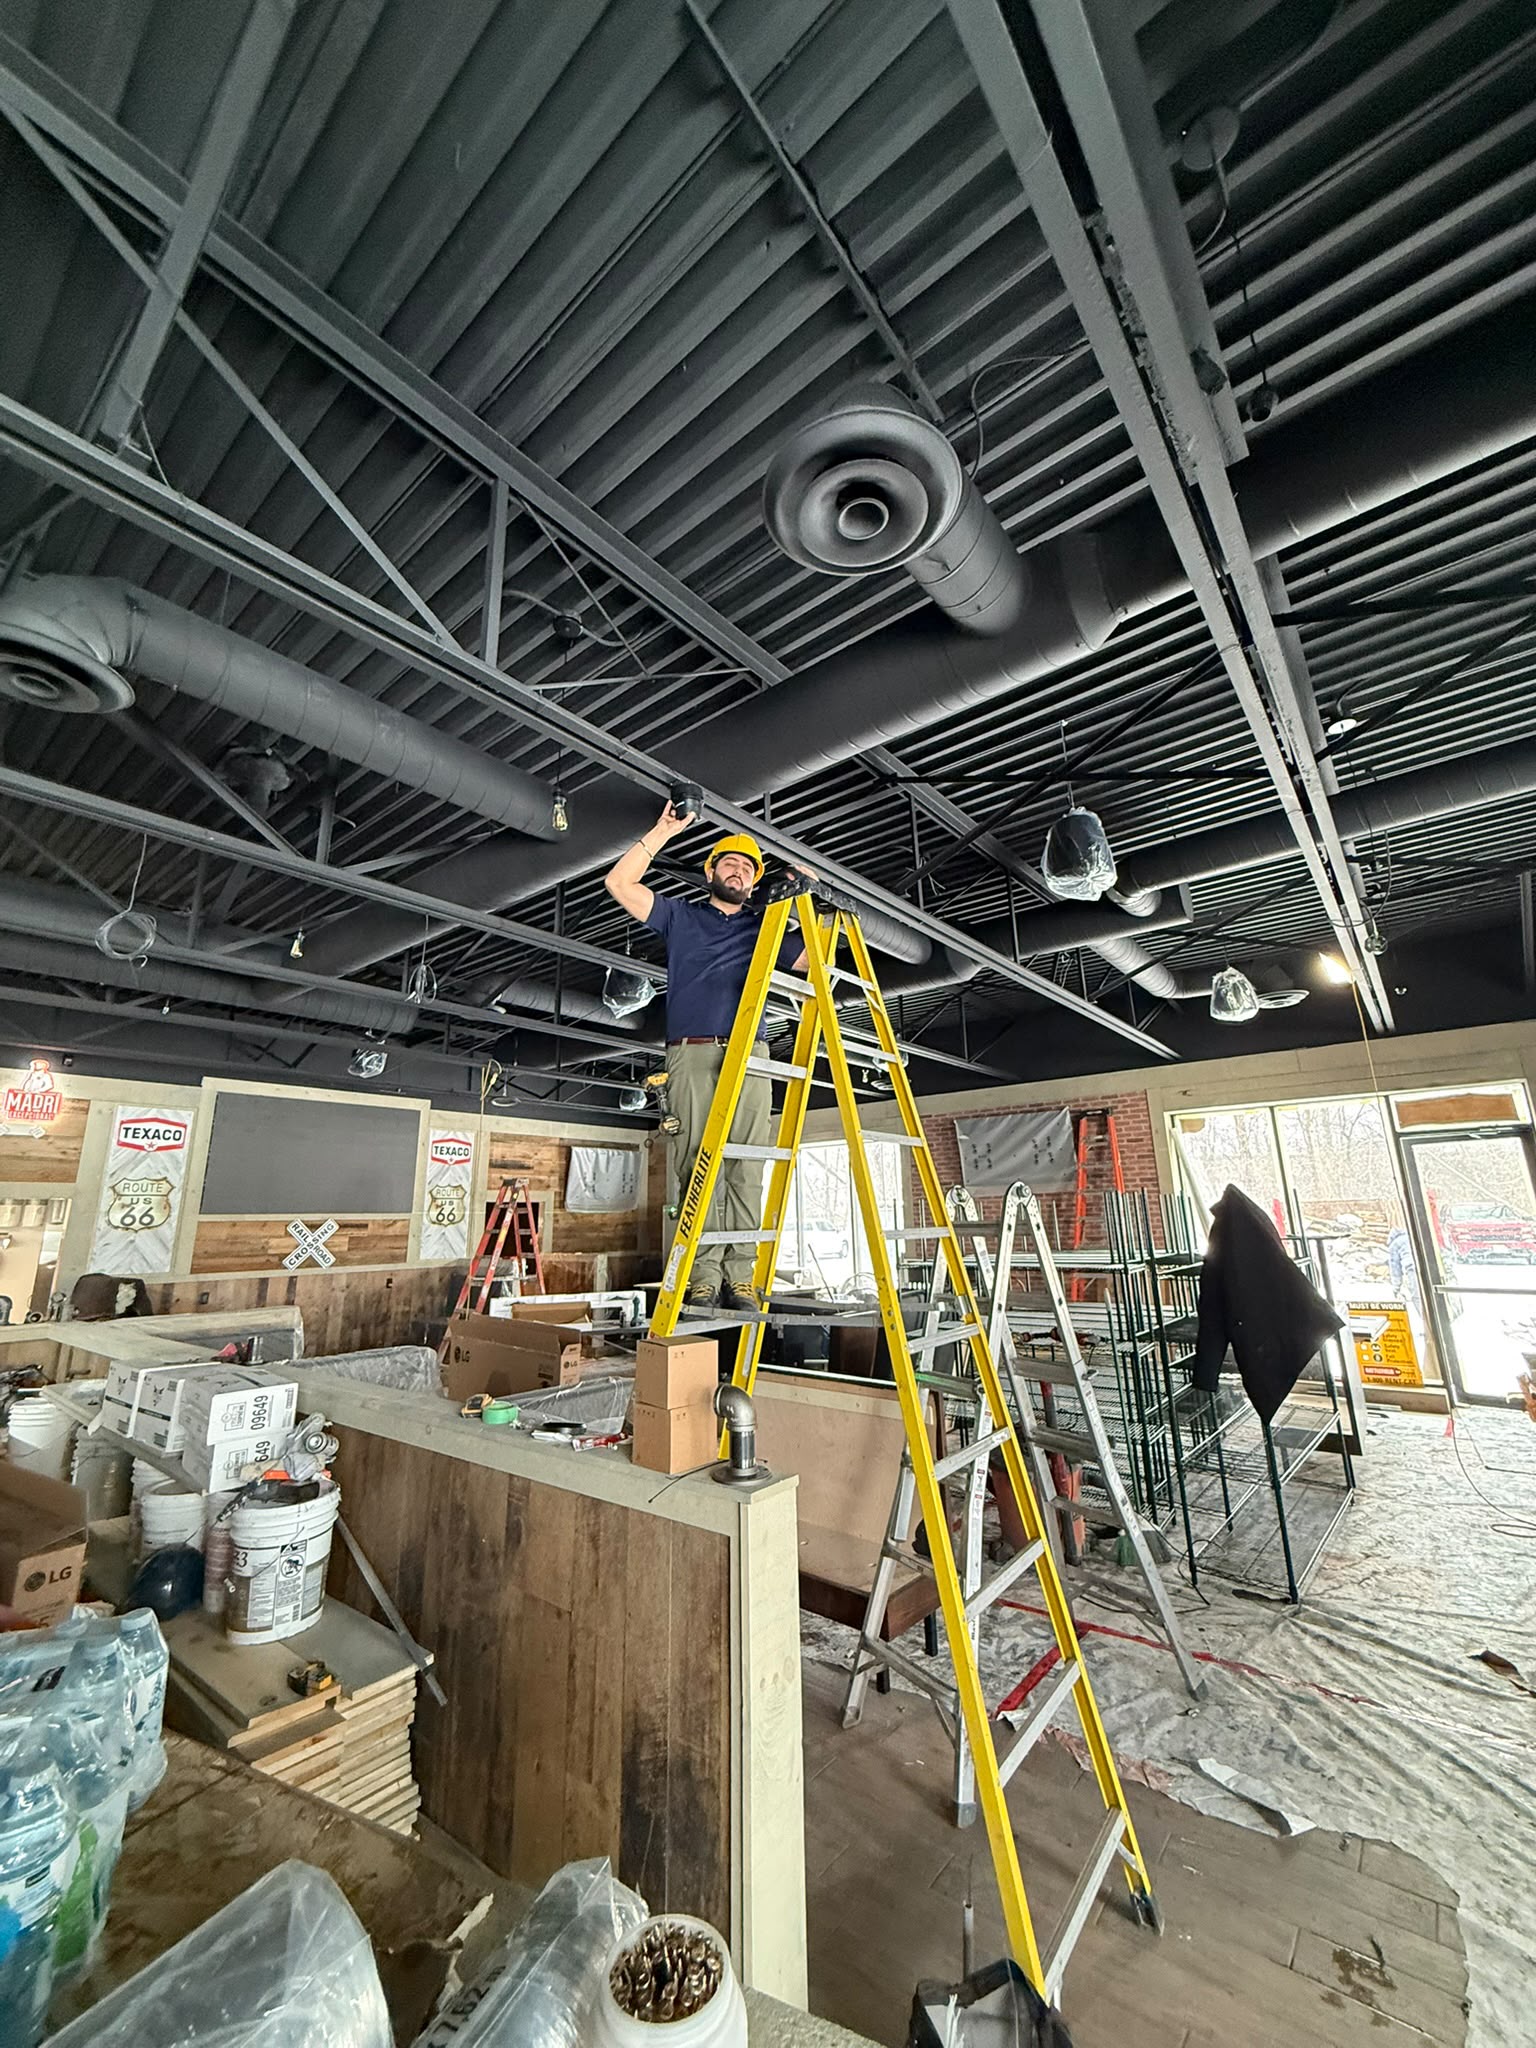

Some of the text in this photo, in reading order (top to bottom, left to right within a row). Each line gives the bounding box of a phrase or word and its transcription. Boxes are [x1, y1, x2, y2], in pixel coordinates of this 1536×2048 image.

[122, 1126, 183, 1142] TEXACO
[434, 1145, 470, 1157] TEXACO
[122, 1182, 165, 1193] ROUTE
[435, 1188, 460, 1197] ROUTE
[680, 1146, 712, 1239] FEATHERLITE
[120, 1206, 155, 1227] 66
[436, 1207, 456, 1223] 66
[288, 1223, 334, 1266] CROSSING
[1381, 1303, 1405, 1311] WORN
[461, 1350, 470, 1363] LG
[250, 1395, 269, 1430] 09649
[254, 1440, 271, 1463] 649
[49, 1566, 72, 1584] LG
